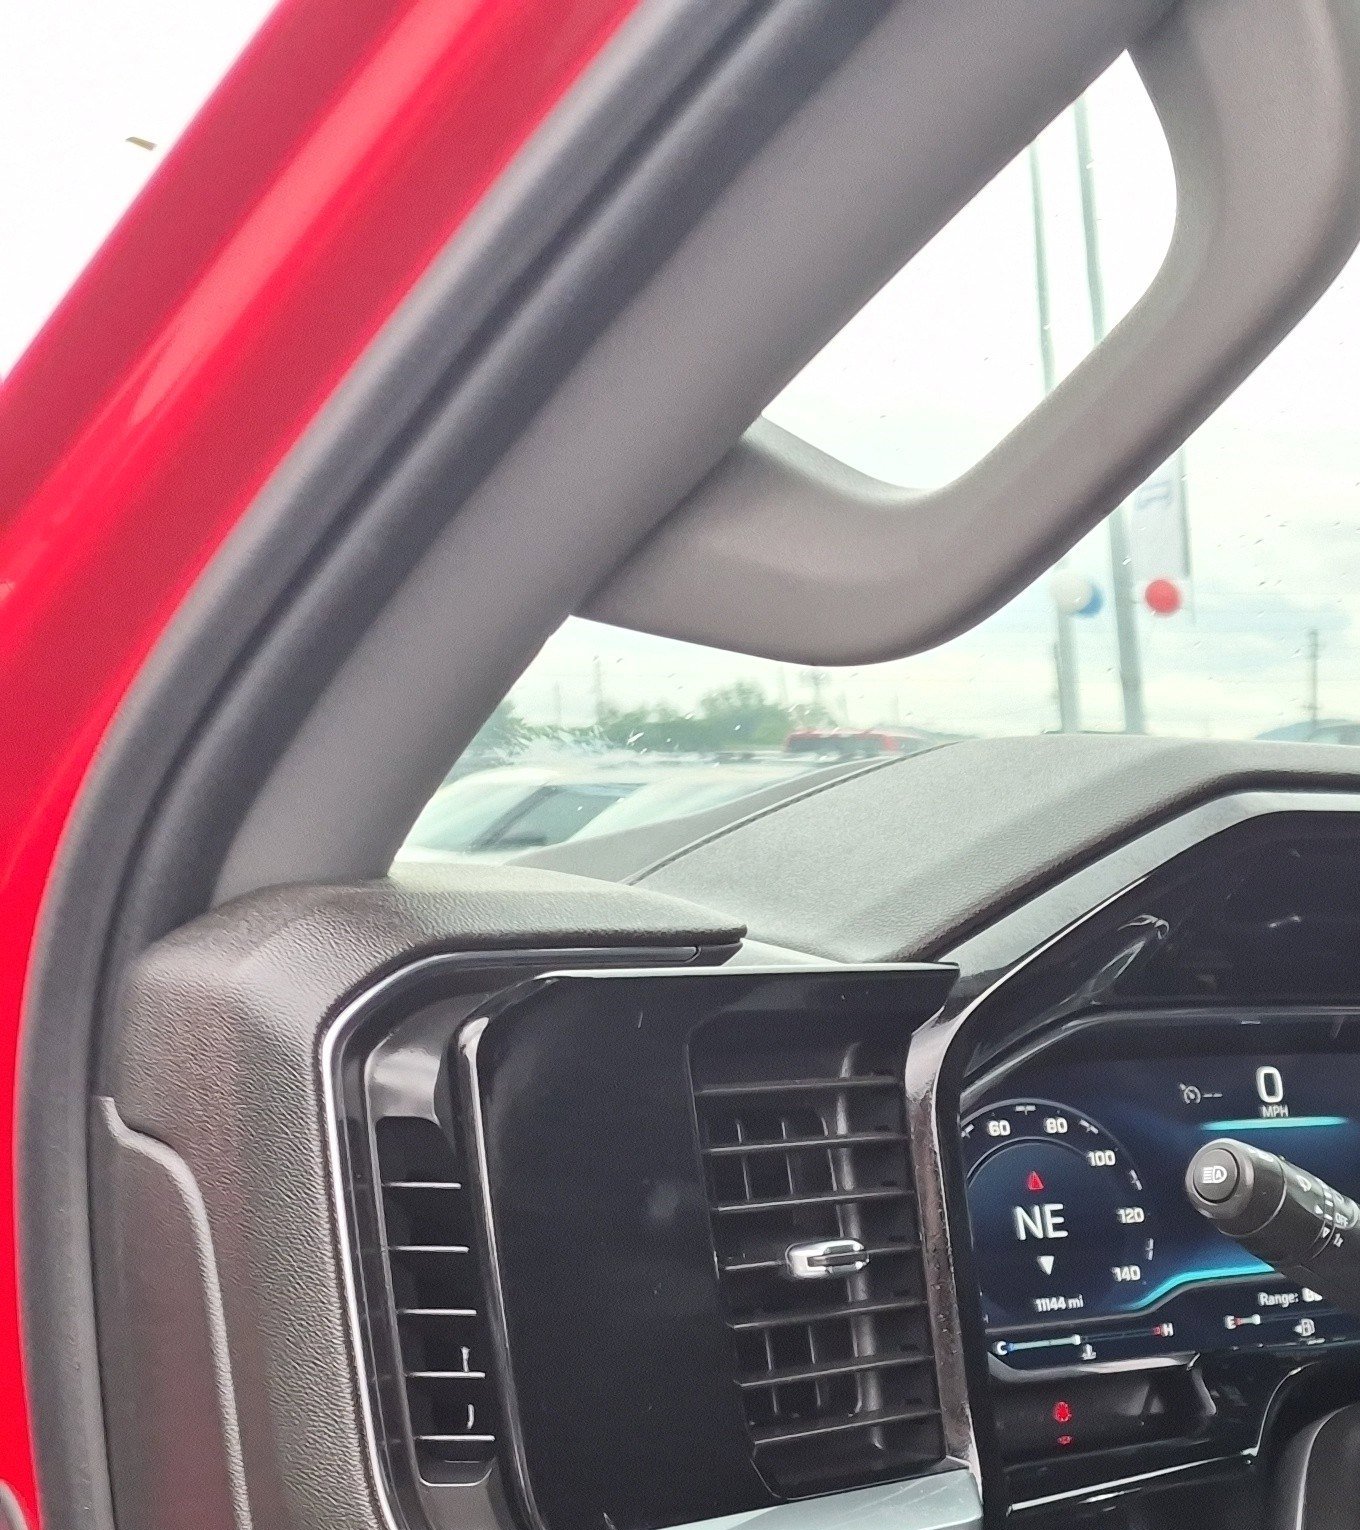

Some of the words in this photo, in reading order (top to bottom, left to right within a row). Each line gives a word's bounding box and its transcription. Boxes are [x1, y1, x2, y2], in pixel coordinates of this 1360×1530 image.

[1255, 1065, 1284, 1104] 0
[1262, 1104, 1289, 1119] MPH
[988, 1119, 1011, 1137] 60
[1046, 1117, 1068, 1134] 80
[1087, 1149, 1116, 1167] 100
[1014, 1203, 1068, 1241] NE
[1117, 1207, 1145, 1224] 120
[1112, 1265, 1141, 1282] 140
[1068, 1294, 1084, 1310] mi
[1258, 1291, 1299, 1308] Range:
